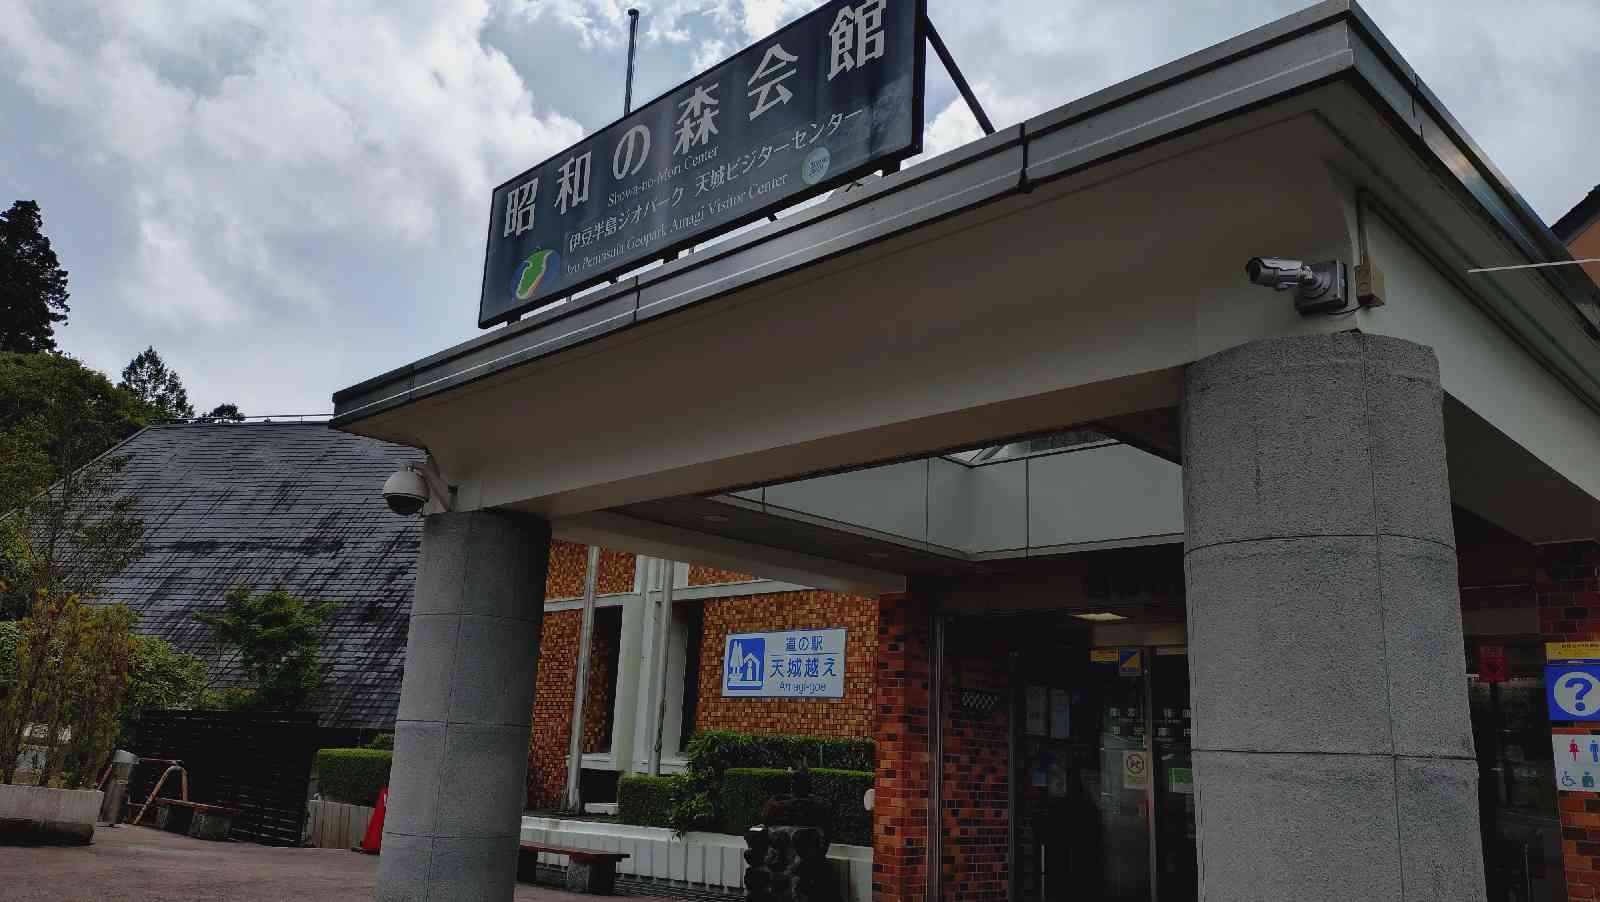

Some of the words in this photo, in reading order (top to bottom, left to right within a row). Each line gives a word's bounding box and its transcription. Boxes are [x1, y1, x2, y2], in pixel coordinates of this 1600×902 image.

[503, 0, 887, 239] 昭和の森会館
[683, 144, 720, 171] Center
[568, 185, 685, 254] 伊豆半島ジオパーク
[694, 108, 865, 198] 天城ビジターセンター
[708, 190, 747, 215] Visitor
[748, 172, 788, 199] Center
[785, 634, 824, 651] 道の駅
[769, 656, 838, 678] 天城越え
